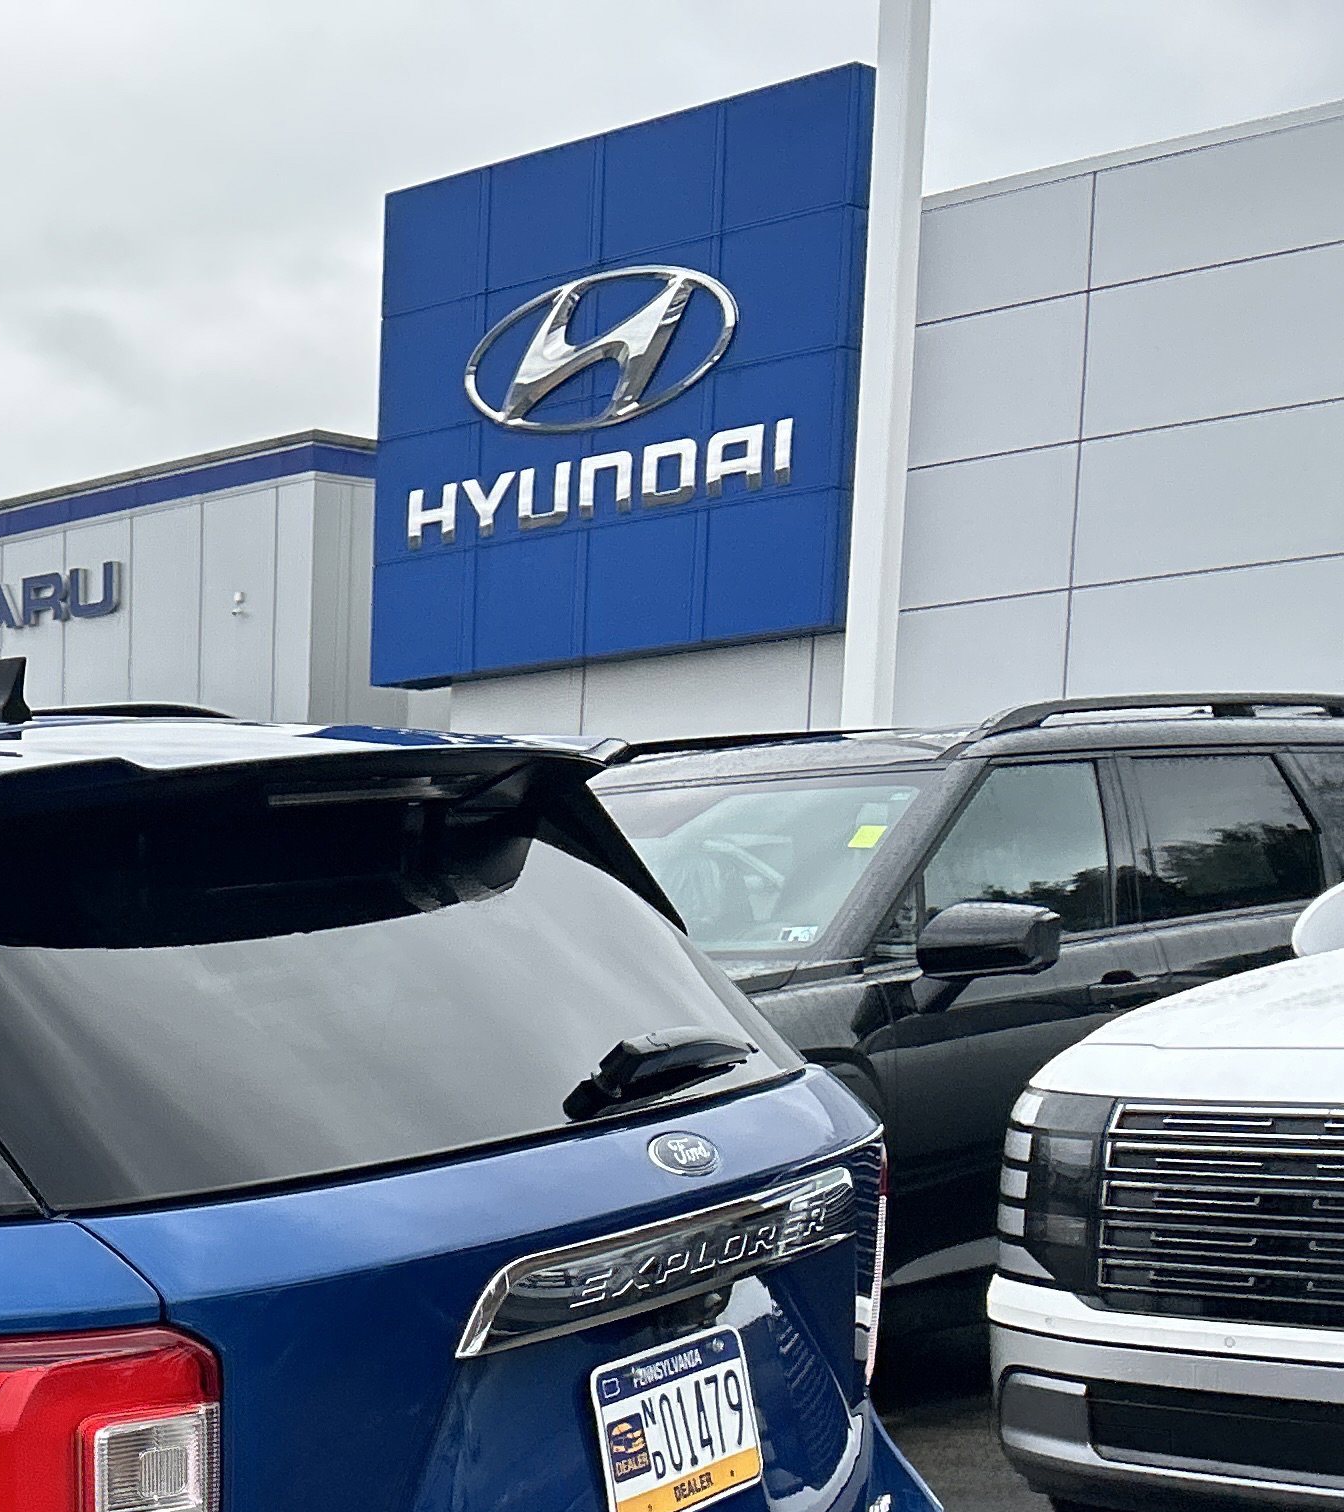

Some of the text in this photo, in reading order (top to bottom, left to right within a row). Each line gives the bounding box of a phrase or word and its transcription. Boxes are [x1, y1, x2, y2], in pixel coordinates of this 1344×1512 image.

[407, 417, 794, 549] HYUNDAI
[667, 1137, 711, 1165] Ford
[569, 1199, 827, 1309] EXPLORER
[674, 1473, 714, 1502] DEALER
